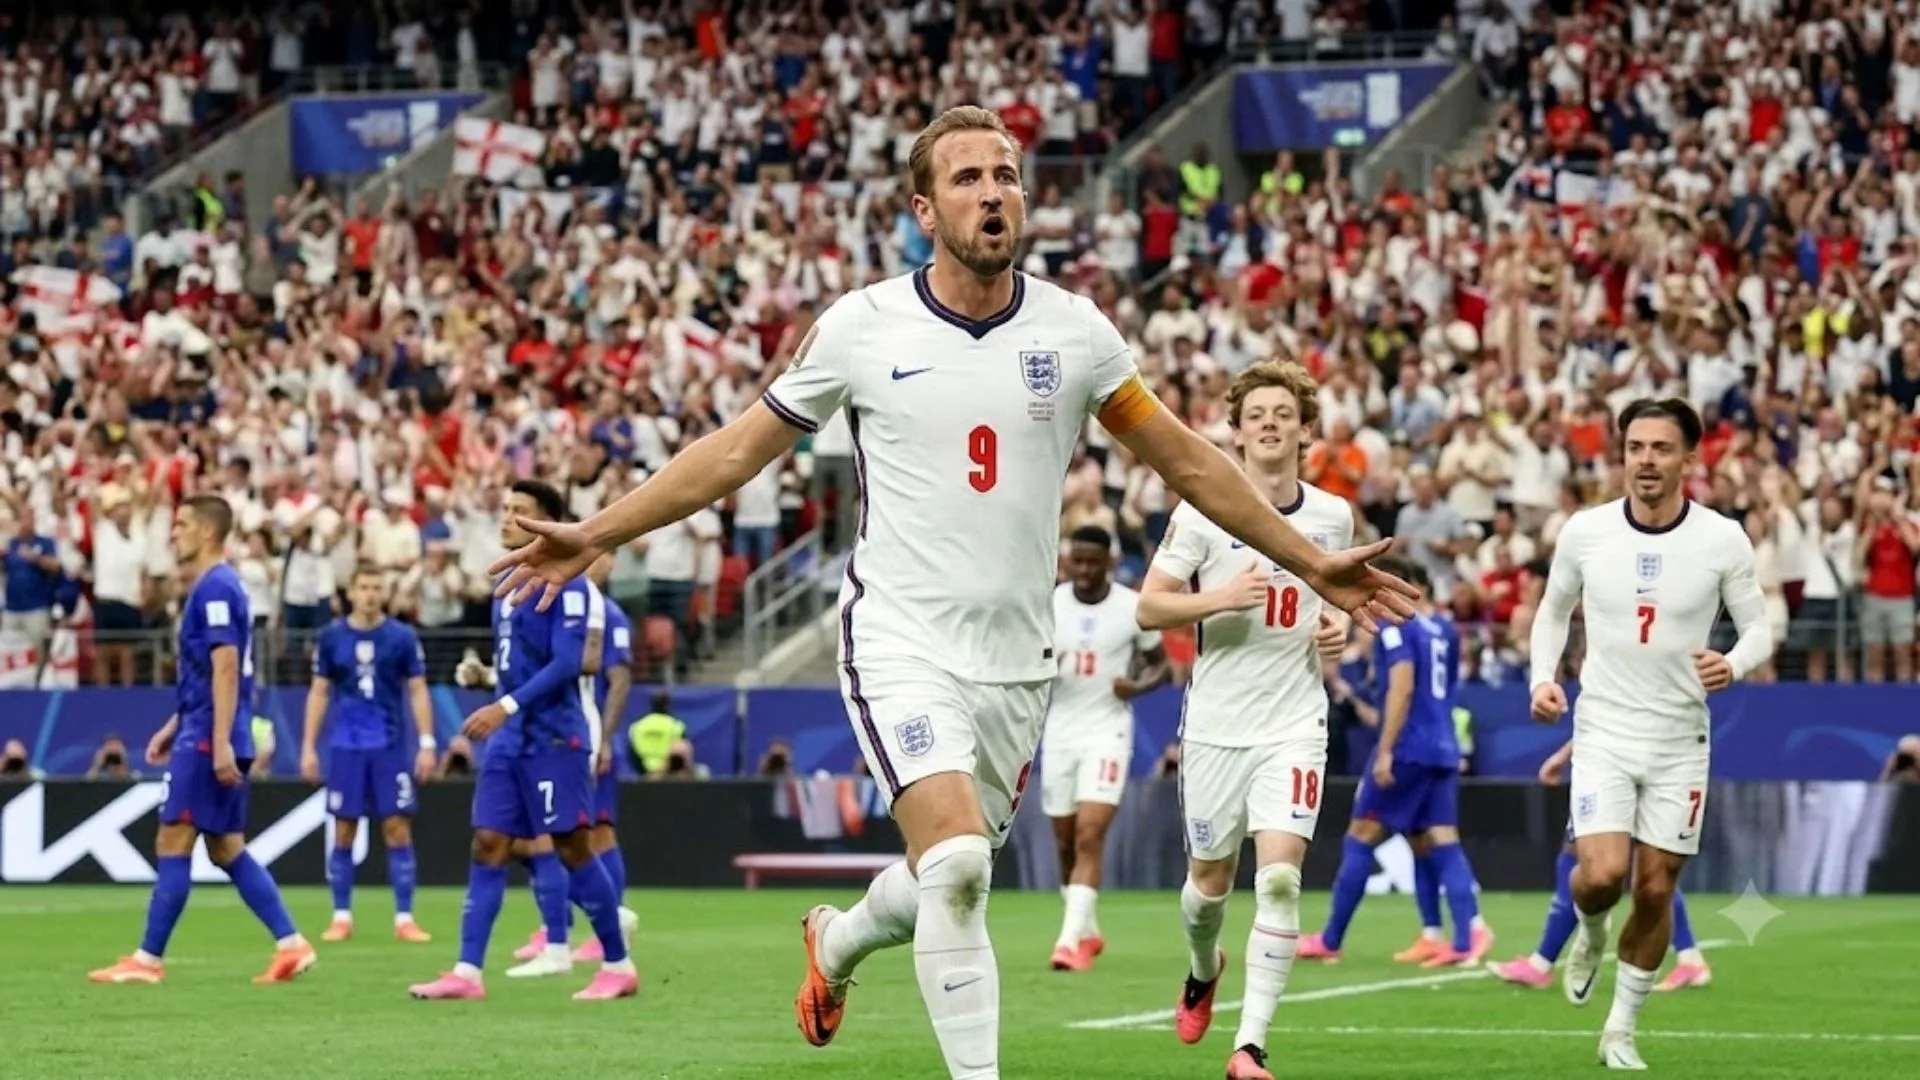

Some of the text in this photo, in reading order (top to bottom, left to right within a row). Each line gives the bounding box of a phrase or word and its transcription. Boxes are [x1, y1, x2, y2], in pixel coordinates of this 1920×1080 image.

[968, 424, 997, 493] 9
[1265, 585, 1298, 628] 18
[1638, 605, 1656, 644] 7
[1431, 638, 1448, 700] 6
[538, 781, 554, 813] 7
[1291, 766, 1318, 810] 18
[1688, 790, 1701, 828] 7
